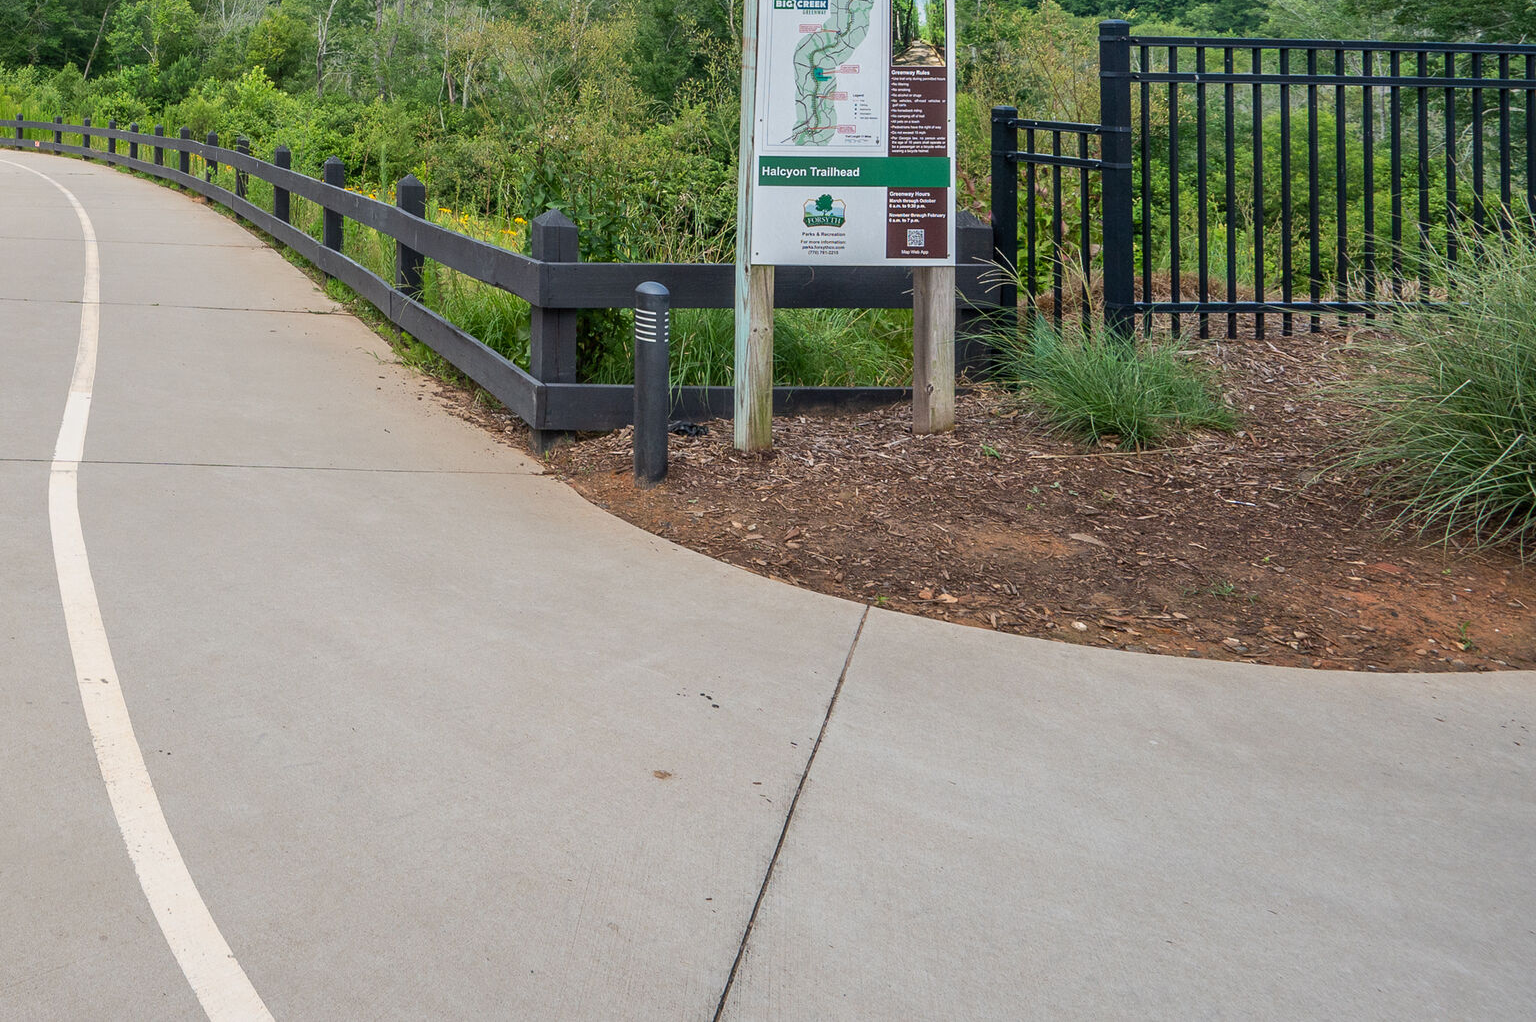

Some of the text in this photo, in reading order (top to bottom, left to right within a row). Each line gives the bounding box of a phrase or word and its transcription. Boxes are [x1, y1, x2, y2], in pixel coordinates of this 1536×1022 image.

[775, 0, 827, 8] BIG CREEK
[761, 166, 860, 179] Halcyon Trailhead
